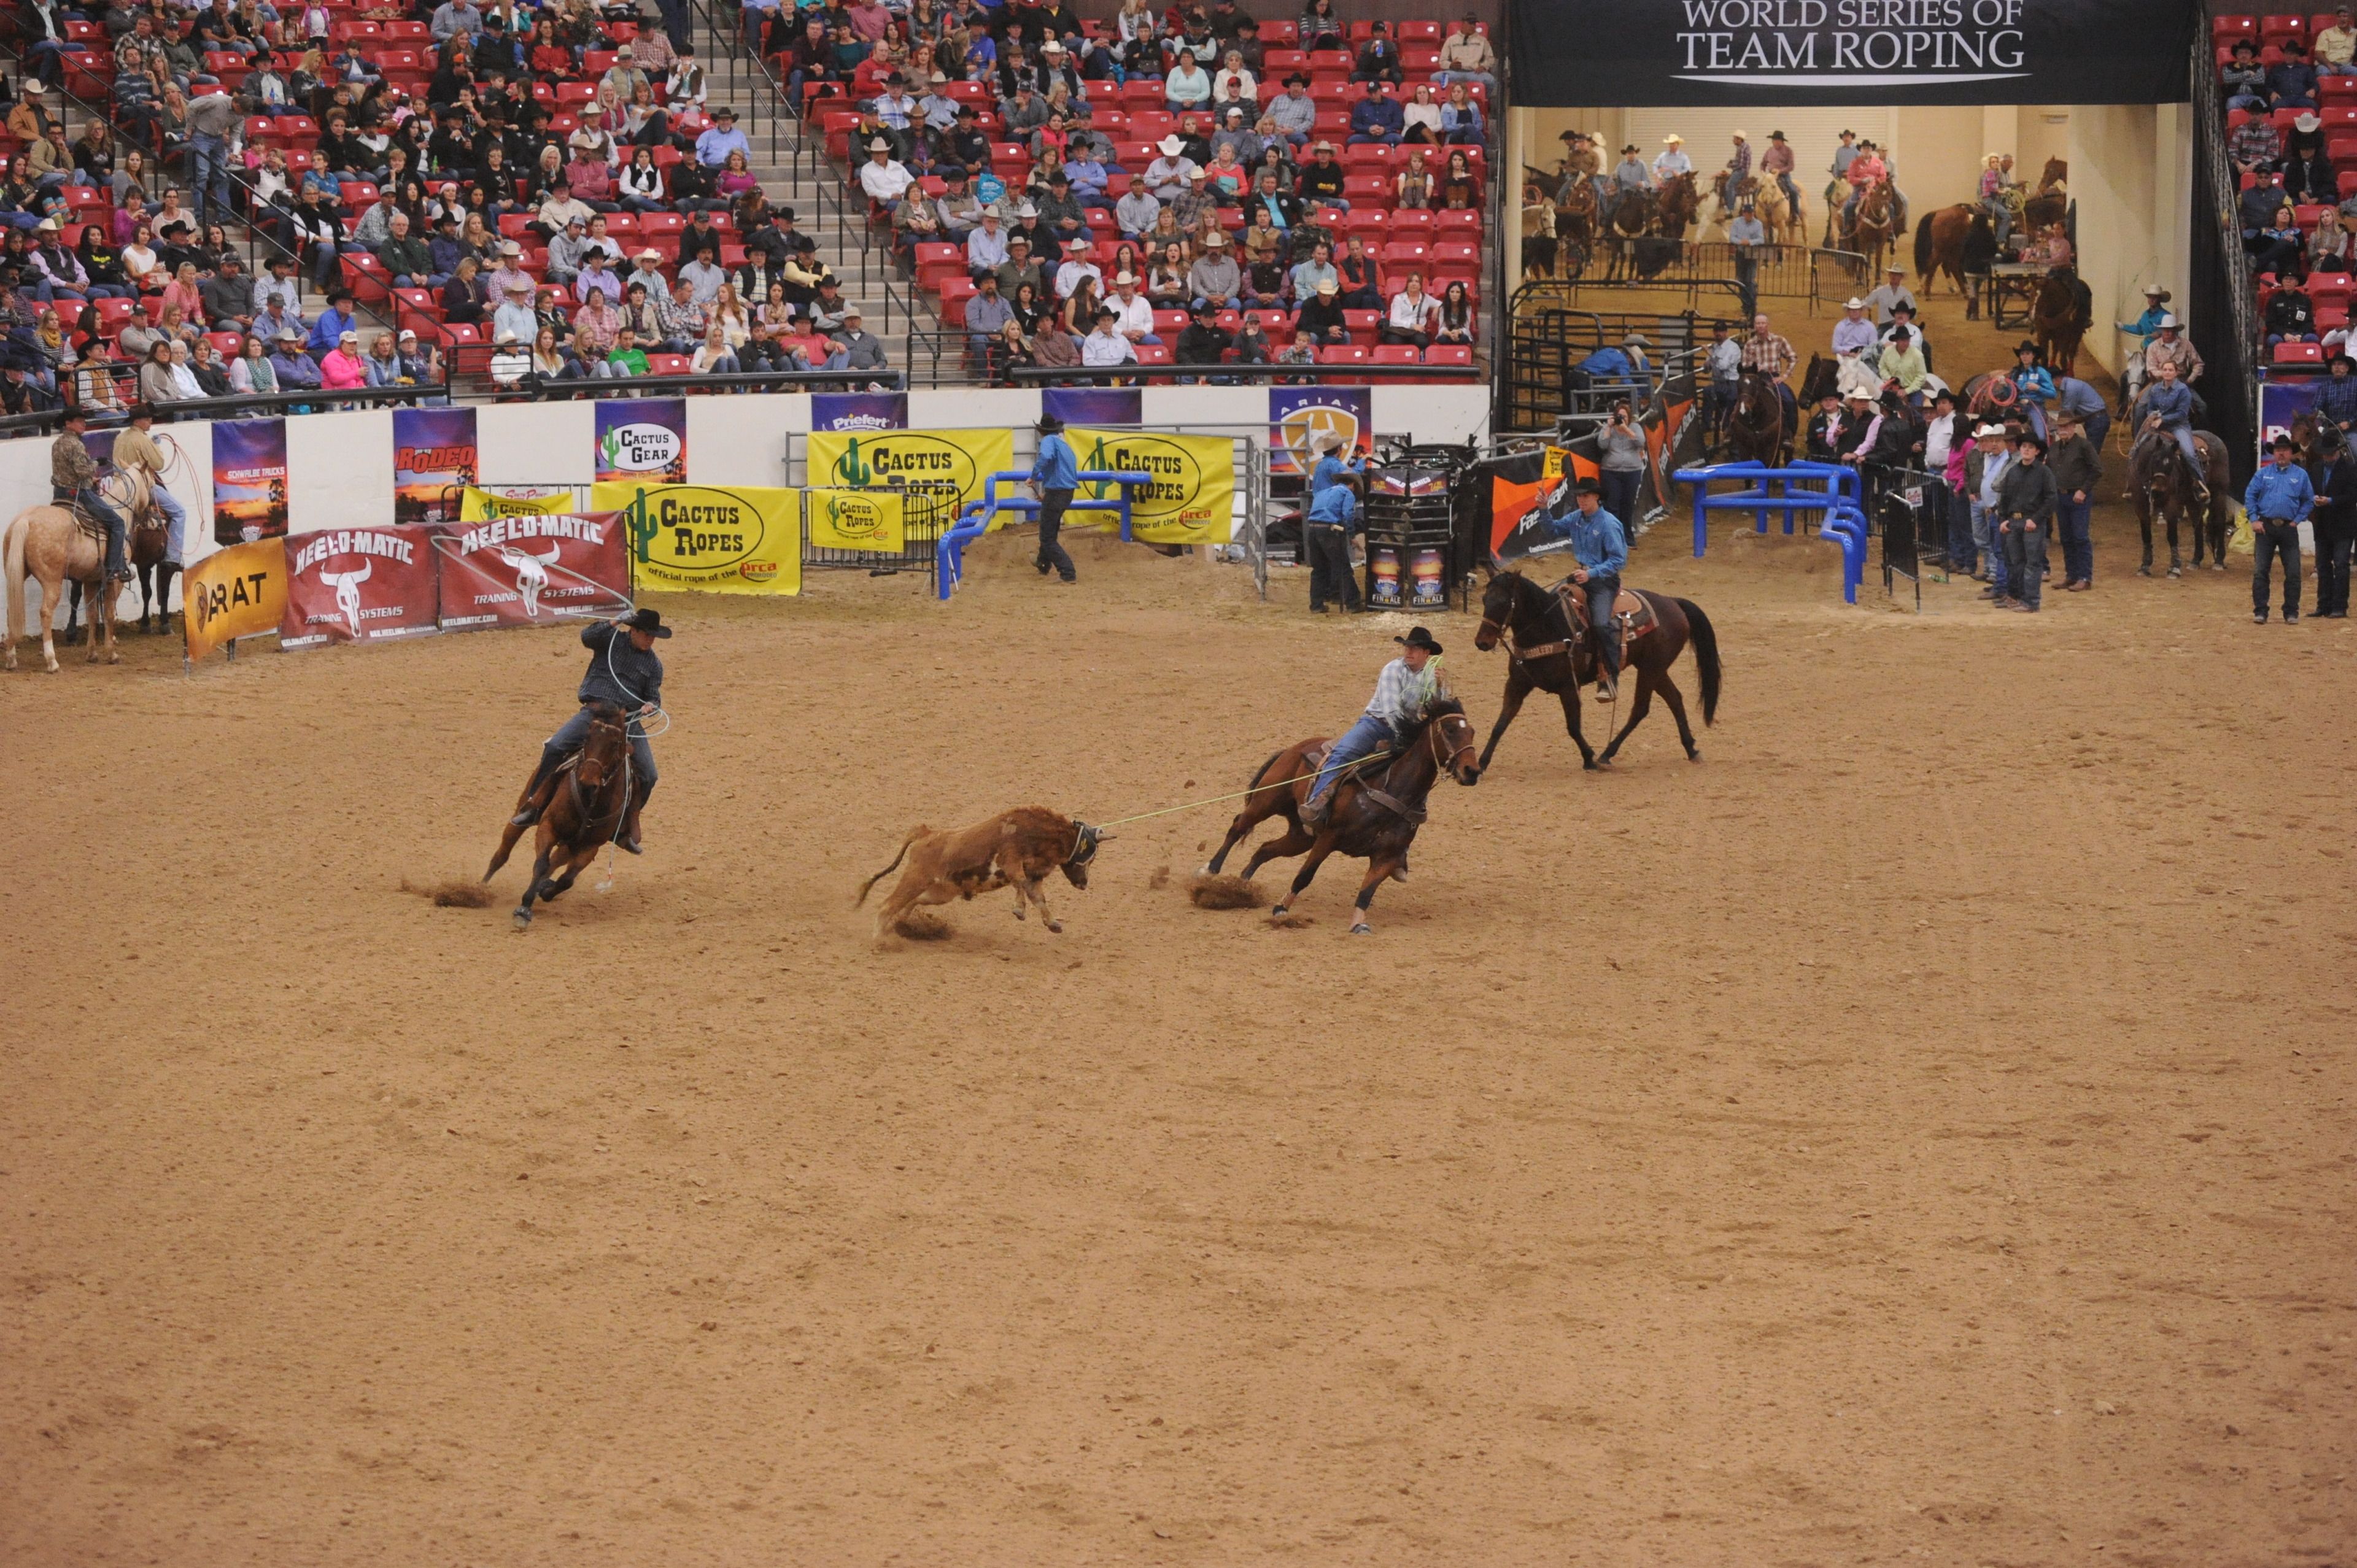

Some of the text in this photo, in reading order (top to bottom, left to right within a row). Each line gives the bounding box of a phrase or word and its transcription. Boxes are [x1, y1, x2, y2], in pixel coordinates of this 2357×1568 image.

[1682, 0, 2022, 27] WORLD SERIES OF
[1676, 31, 2024, 68] TEAM ROPING
[1281, 397, 1359, 415] ARIAT
[832, 413, 888, 430] Priefert
[621, 430, 669, 447] CACTUS
[396, 446, 475, 473] RODEO
[632, 447, 668, 463] GEAR
[873, 448, 952, 475] CACTUS
[1116, 449, 1182, 474] CACTUS
[261, 466, 285, 476] TRUCKS
[500, 504, 539, 516] CACTUS
[660, 499, 740, 527] CACTUS
[840, 501, 872, 514] CACTUS
[1132, 522, 1150, 530] rope
[1153, 519, 1160, 528] of
[1163, 516, 1176, 526] the
[675, 528, 743, 556] ROPES
[648, 567, 737, 584] official rope of the
[741, 562, 777, 578] prca
[207, 572, 267, 622] ARAT
[474, 585, 595, 604] TRAINING SYSTEMS
[360, 606, 403, 620] SYSTEMS
[442, 614, 498, 627] HEELOMATIC.COM
